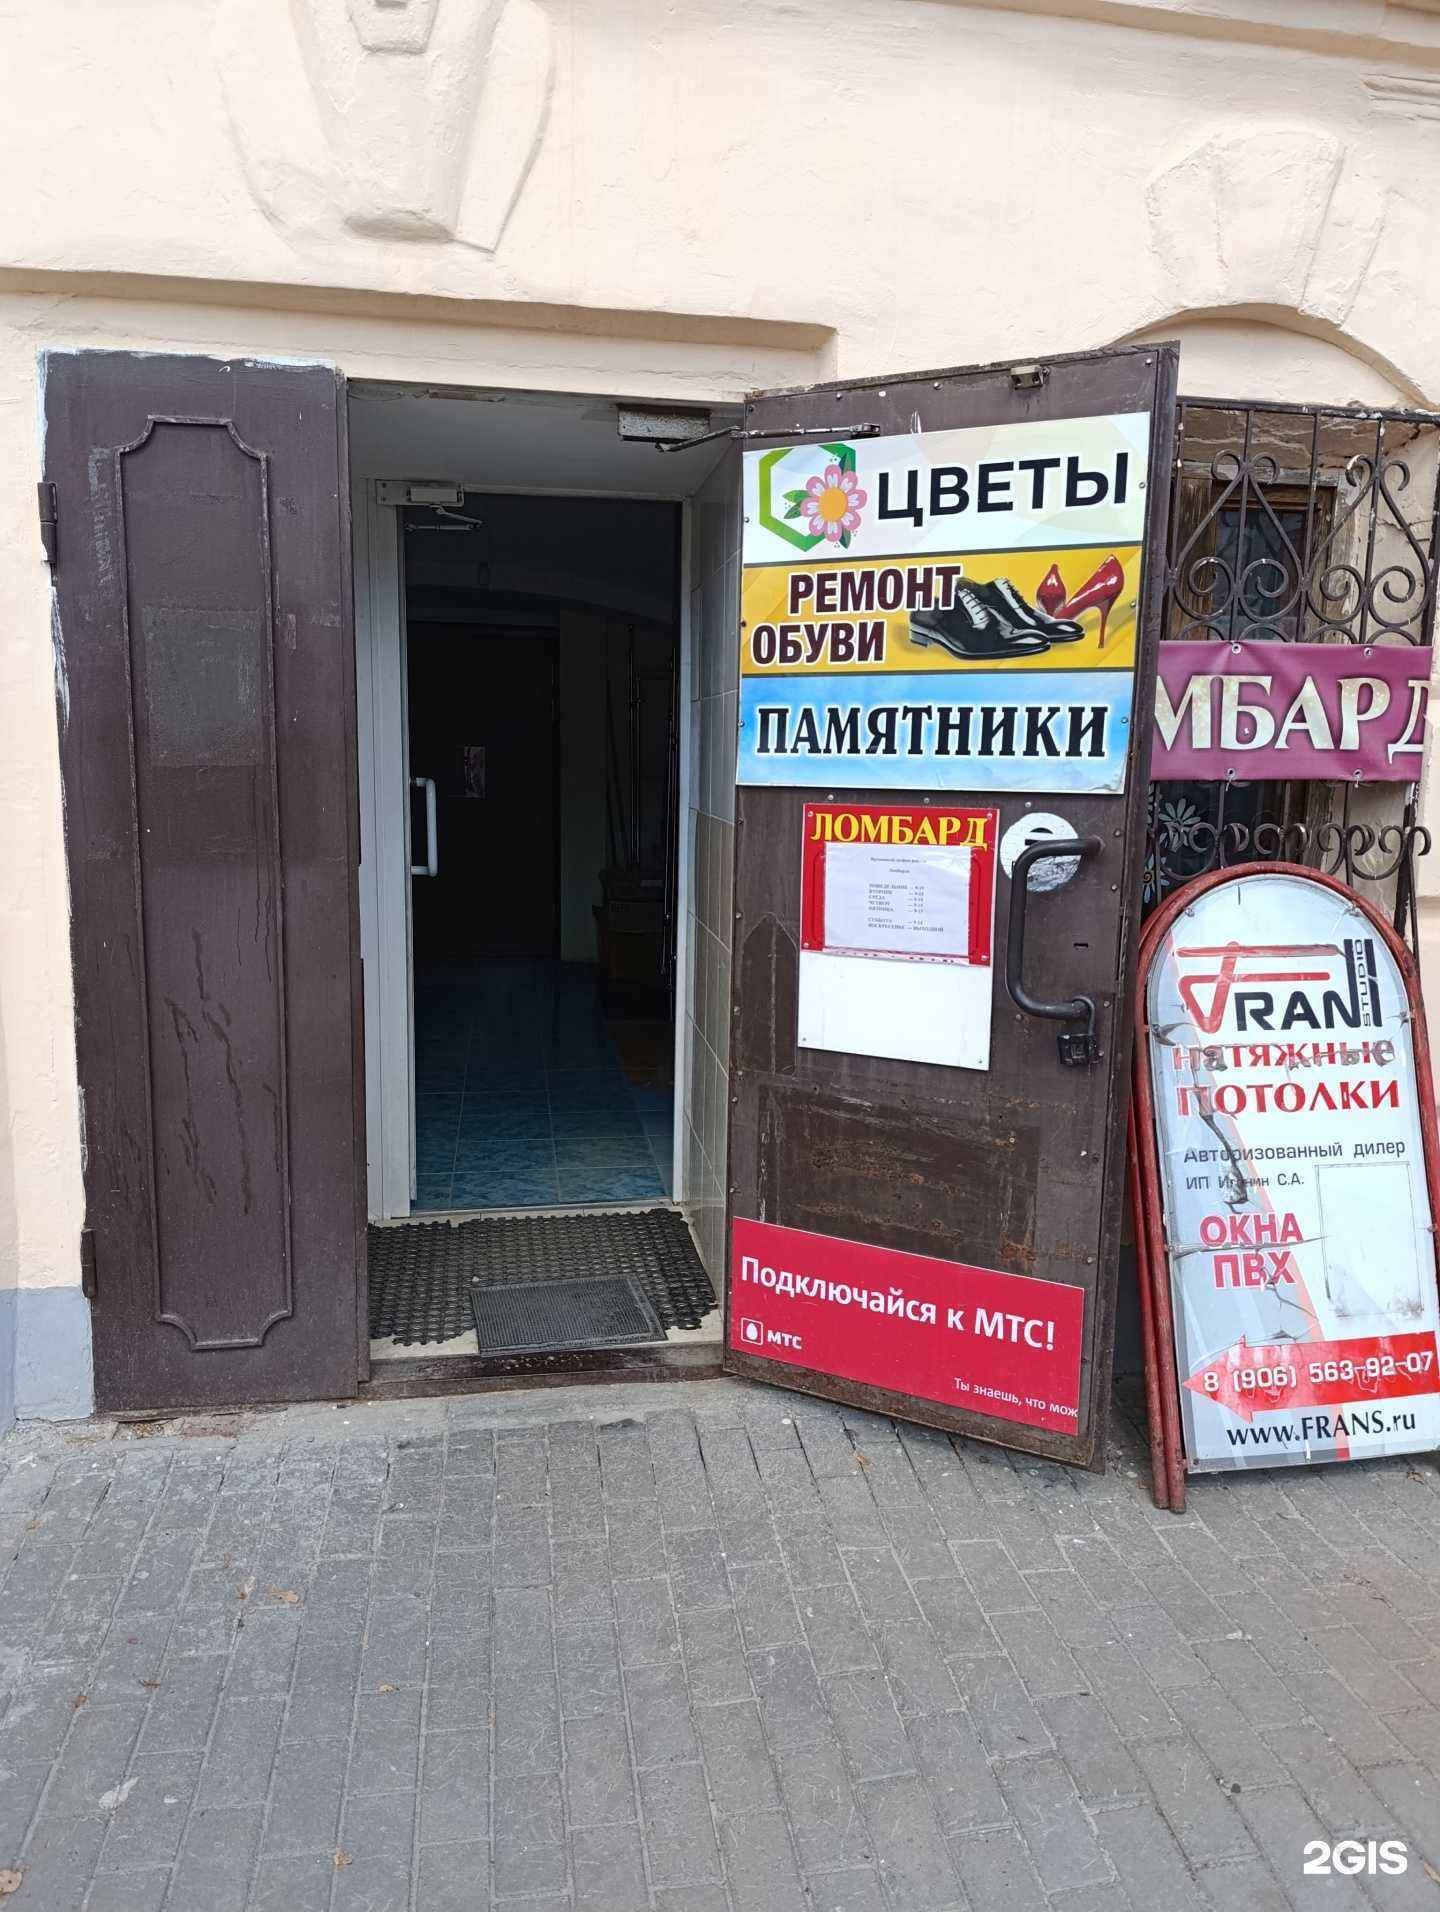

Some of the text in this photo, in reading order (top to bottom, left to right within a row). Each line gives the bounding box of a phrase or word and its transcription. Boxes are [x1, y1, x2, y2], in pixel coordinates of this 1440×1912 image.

[877, 452, 1129, 527] ЦВЕТЫ
[789, 566, 960, 614] РЕМОНТ
[752, 621, 886, 665] ОБУВИ
[757, 705, 1108, 757] ПАМЯТНИКИ
[811, 813, 988, 851] ЛОМБАРД
[1354, 938, 1371, 1028] STUDIO
[1183, 1141, 1405, 1163] Авторизованный дилер
[1186, 1176, 1209, 1190] ИП
[1278, 1172, 1304, 1186] С.А.
[1200, 1212, 1304, 1247] ОКНА
[1213, 1251, 1296, 1289] ПВХ
[741, 1255, 1055, 1351] Подключайся к МТС!
[1203, 1351, 1434, 1392] 8 (906) 563-92-07
[954, 1377, 970, 1391] Ты
[973, 1384, 1022, 1406] знаешь,
[1026, 1397, 1047, 1410] что
[1226, 1410, 1416, 1446] www.FRANS.ru
